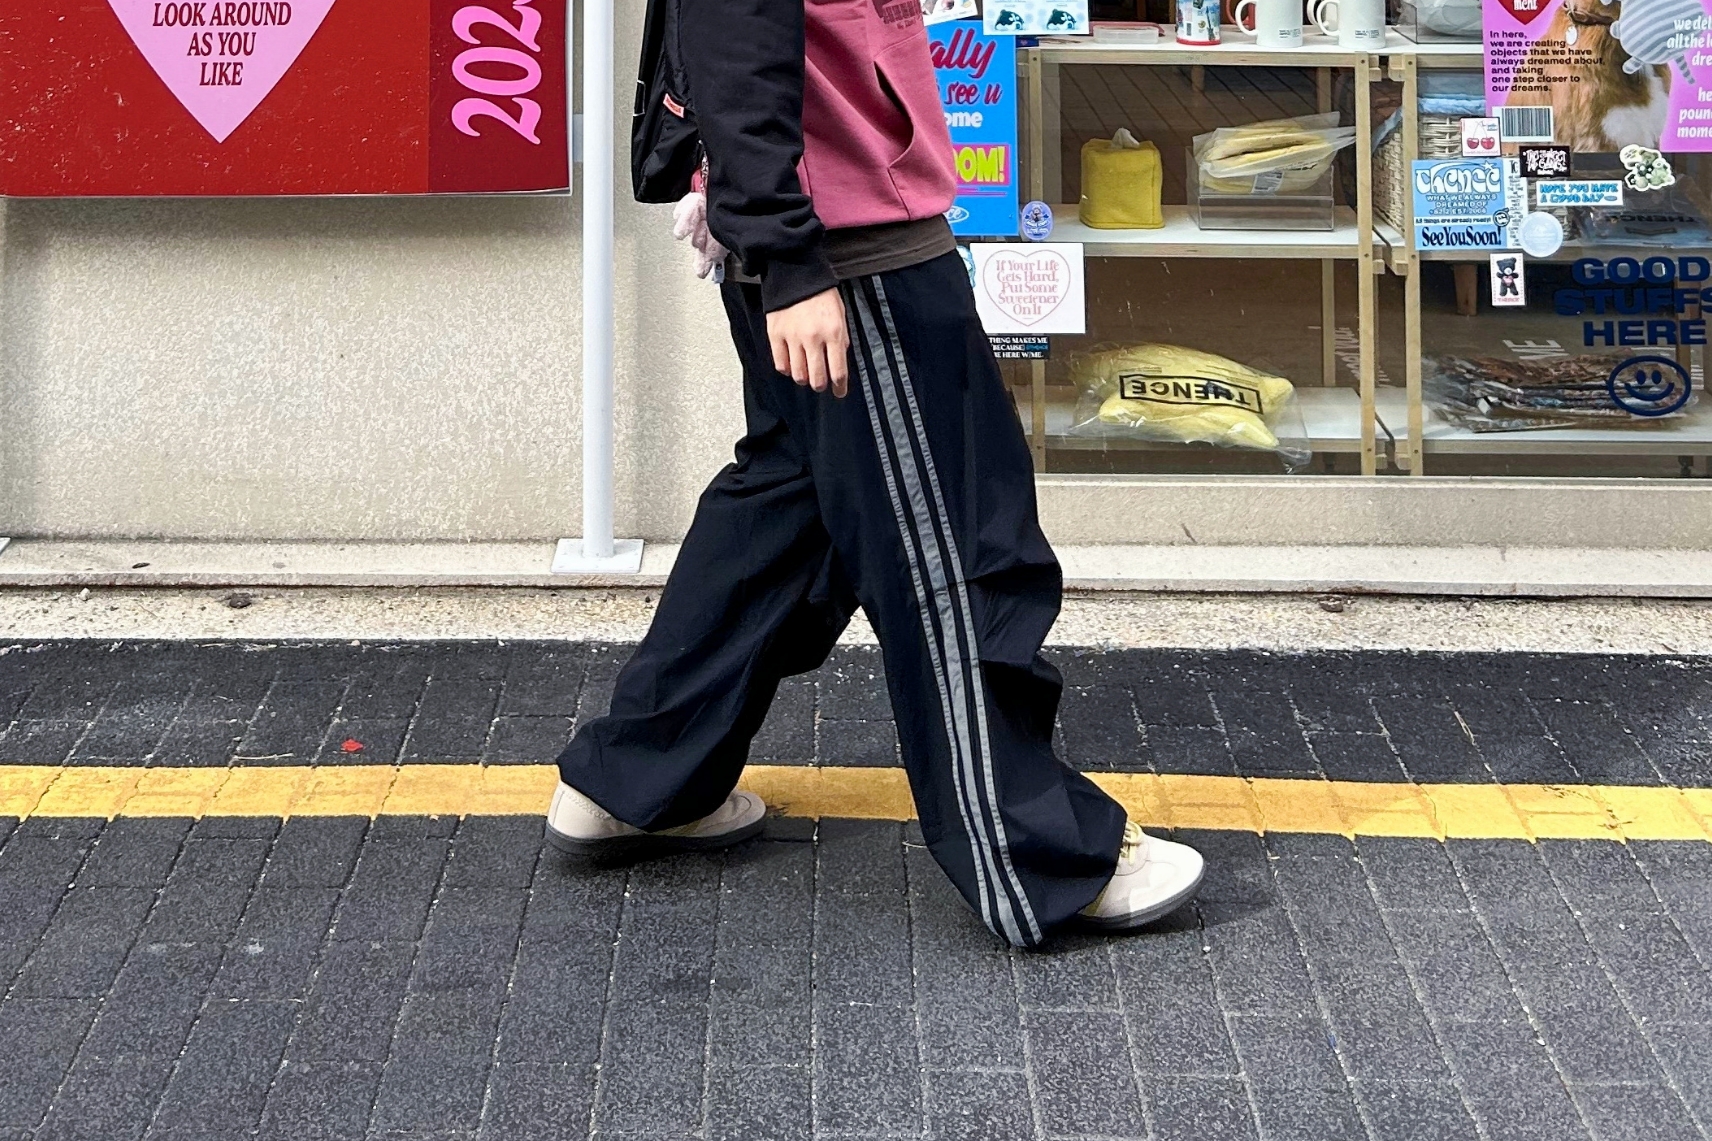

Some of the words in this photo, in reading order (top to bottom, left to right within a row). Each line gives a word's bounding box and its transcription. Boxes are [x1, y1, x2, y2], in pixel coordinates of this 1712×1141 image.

[152, 2, 206, 28] LOOK
[210, 2, 292, 27] AROUND
[1673, 20, 1692, 32] we
[1490, 30, 1500, 39] In
[1502, 30, 1528, 40] here,
[1666, 33, 1685, 49] all
[1684, 33, 1705, 49] the
[187, 32, 214, 57] AS
[218, 32, 257, 57] YOU
[1524, 39, 1567, 50] creating
[1490, 48, 1528, 58] objects
[1529, 48, 1550, 57] that
[1551, 49, 1567, 57] we
[1568, 48, 1593, 57] have
[1491, 57, 1526, 67] always
[1527, 57, 1573, 66] dreamed
[1574, 57, 1606, 67] about,
[199, 63, 243, 86] LIKE
[1491, 66, 1510, 75] and
[1512, 66, 1544, 76] taking
[1491, 76, 1511, 84] one
[1512, 75, 1535, 85] step
[1536, 75, 1569, 84] closer
[1569, 75, 1581, 84] to
[944, 78, 982, 106] see
[984, 82, 1004, 106] u
[1491, 85, 1509, 93] our
[1511, 84, 1552, 93] dreams.
[1426, 194, 1450, 202] WHAT
[1465, 193, 1497, 201] ALWAYS
[996, 259, 1006, 273] If
[1007, 259, 1036, 272] Your
[1036, 259, 1060, 272] Life
[1571, 257, 1711, 286] GOOD
[996, 271, 1022, 283] Gets
[1024, 271, 1060, 283] Hard,
[1001, 282, 1022, 294] Put
[1024, 281, 1058, 294] Some
[998, 293, 1059, 305] Sweetener
[1012, 304, 1032, 316] On
[1583, 319, 1708, 347] HERE
